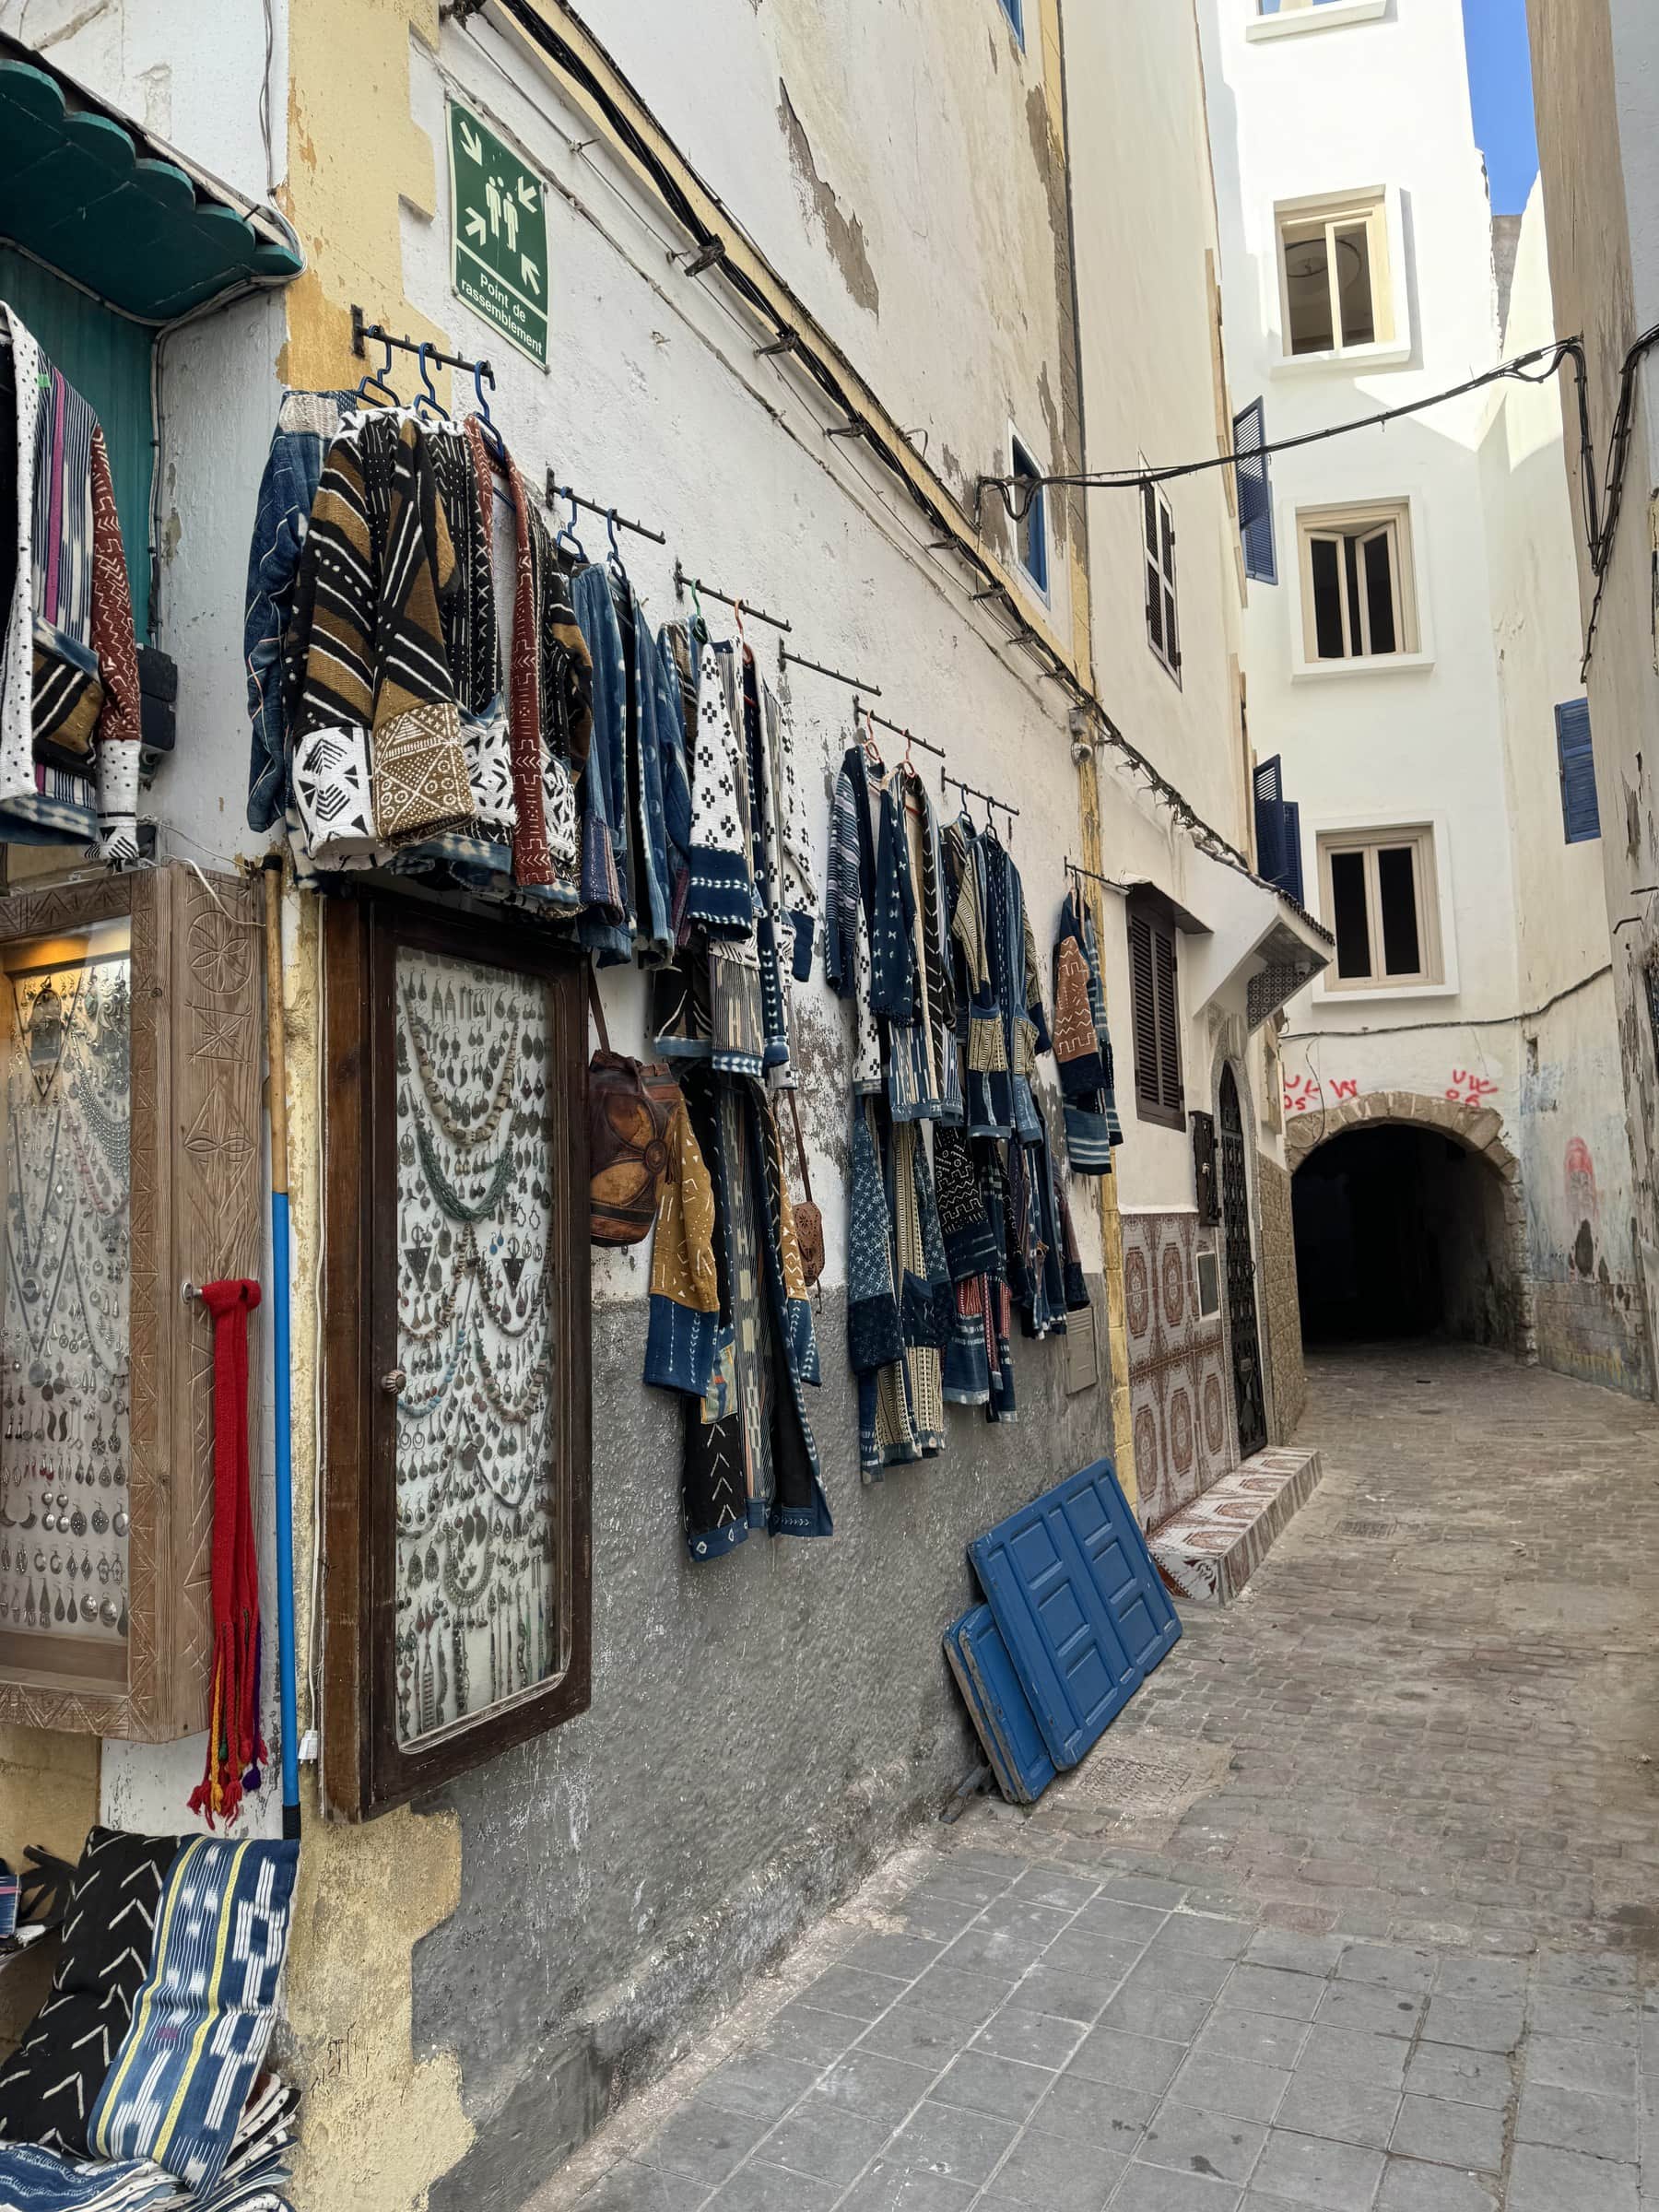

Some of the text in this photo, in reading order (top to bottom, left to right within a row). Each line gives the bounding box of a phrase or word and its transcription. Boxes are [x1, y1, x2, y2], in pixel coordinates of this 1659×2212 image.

[461, 279, 543, 356] rassemblement
[480, 273, 526, 323] Point de
